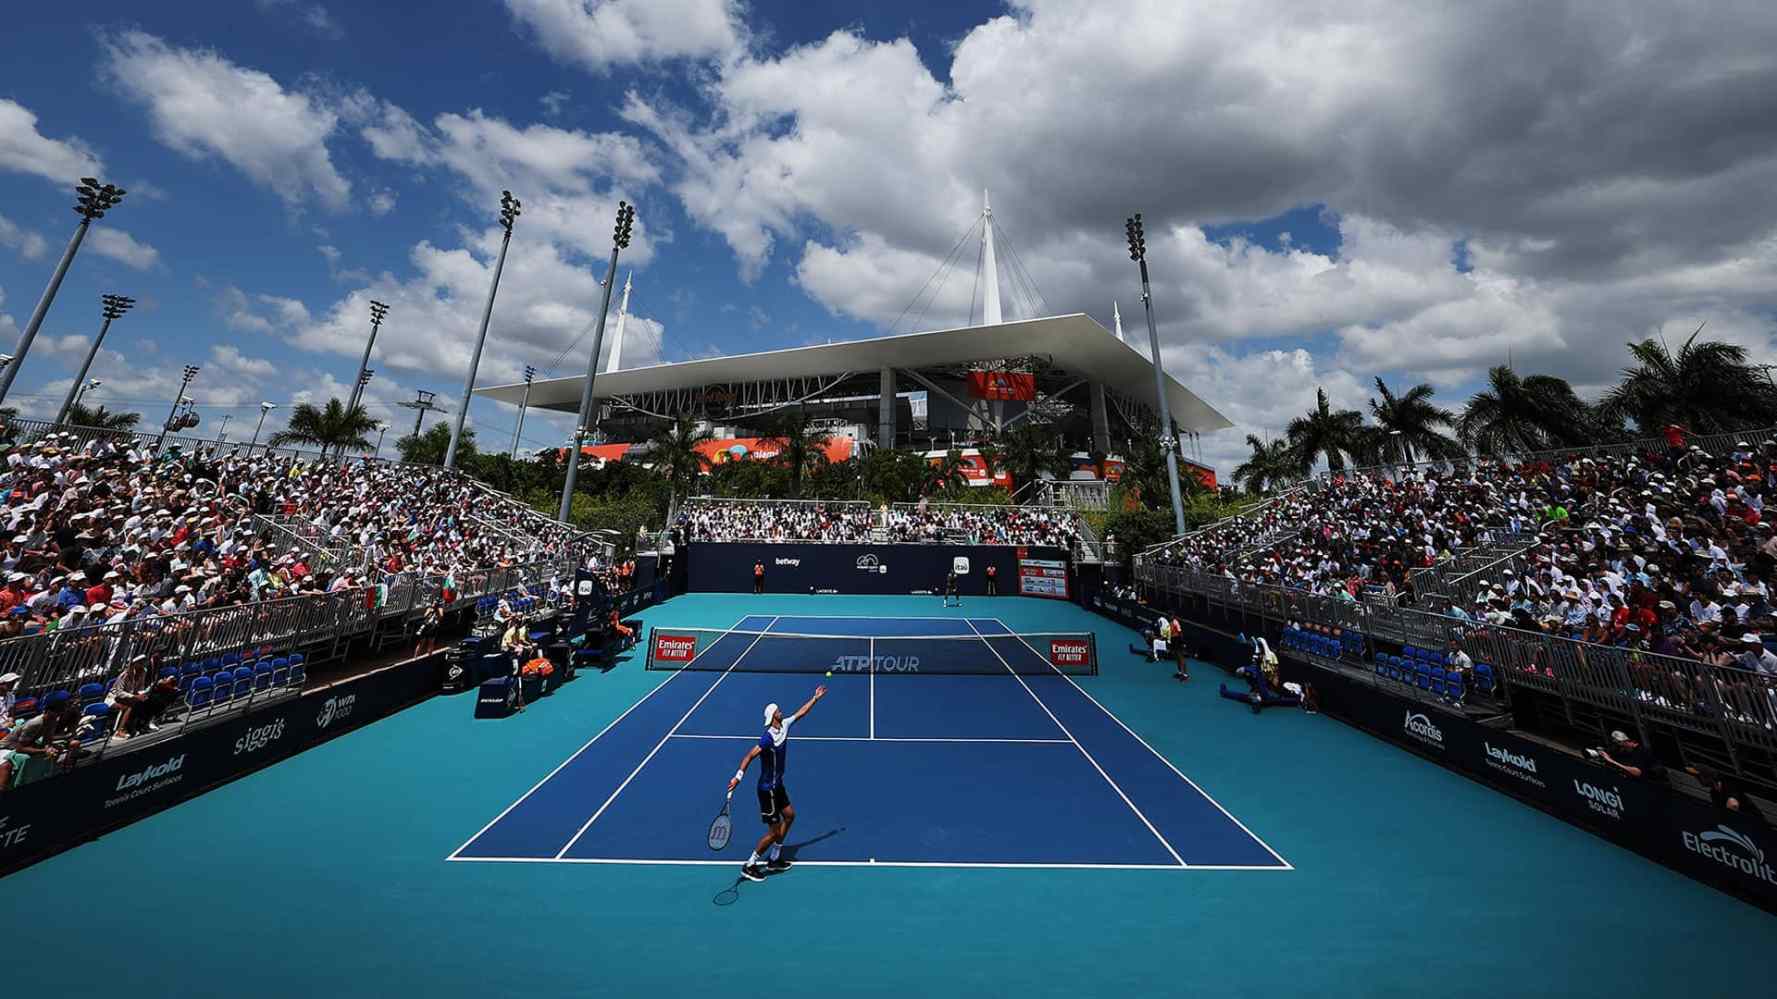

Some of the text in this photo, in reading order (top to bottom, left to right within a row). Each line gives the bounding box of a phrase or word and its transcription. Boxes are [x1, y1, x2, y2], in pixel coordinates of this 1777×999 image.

[776, 558, 800, 567] betway
[658, 639, 693, 650] Emirates
[1052, 644, 1087, 654] Emirates
[874, 655, 920, 672] TOUR
[1484, 741, 1537, 773] Laykold
[115, 753, 187, 792] Laykold
[1682, 831, 1777, 885] Electrolit
